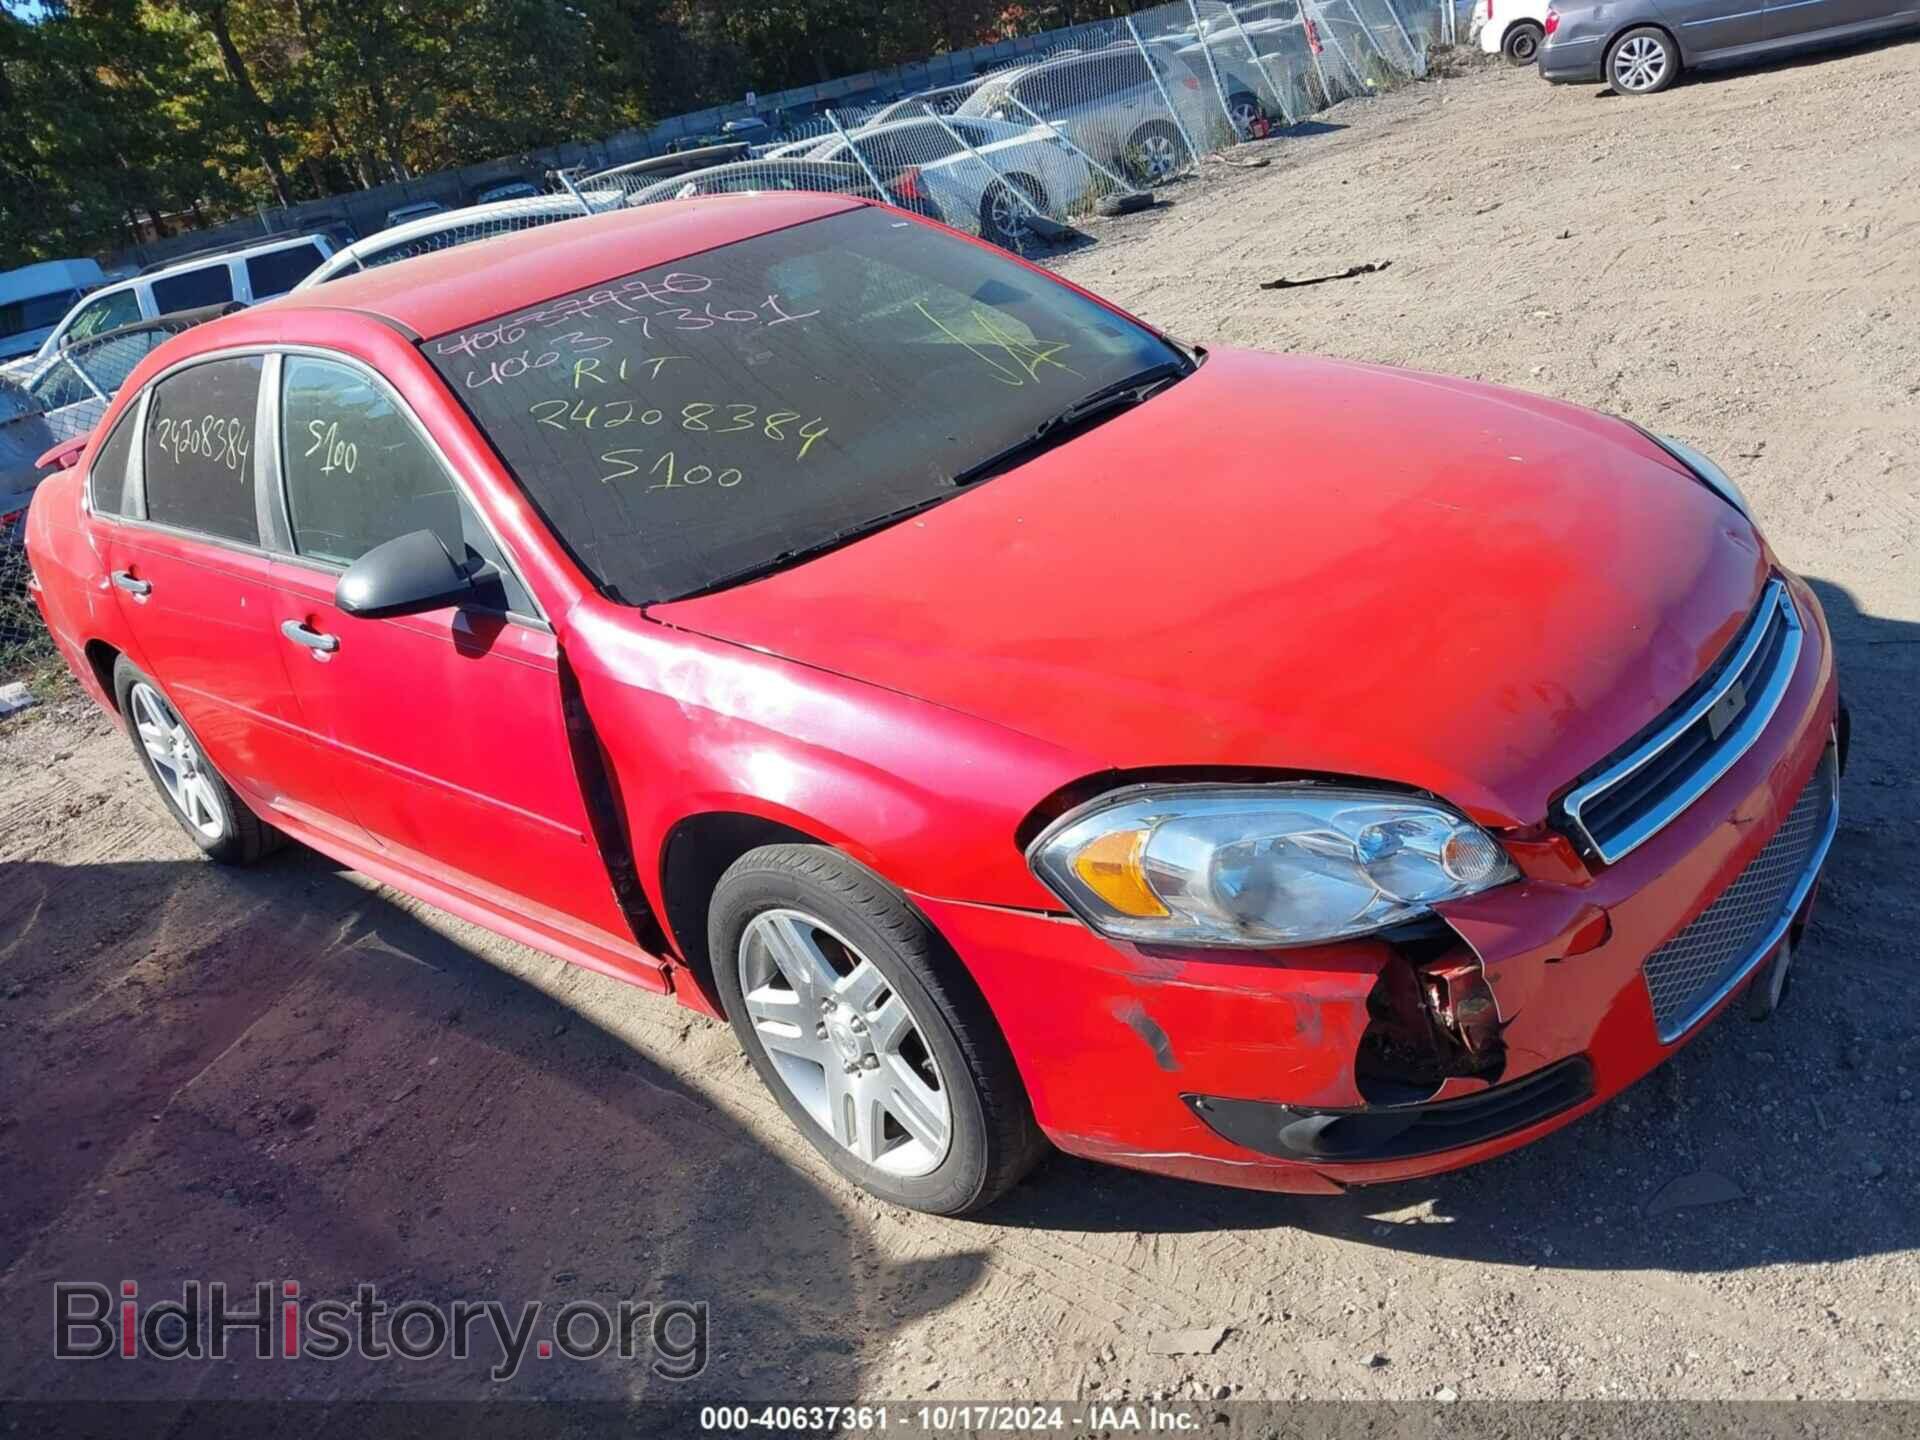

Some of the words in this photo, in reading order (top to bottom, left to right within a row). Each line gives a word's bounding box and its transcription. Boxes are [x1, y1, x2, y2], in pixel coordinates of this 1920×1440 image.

[156, 414, 250, 485] 24208384
[304, 419, 357, 477] S100
[529, 399, 830, 461] 24208384
[600, 449, 743, 493] S100
